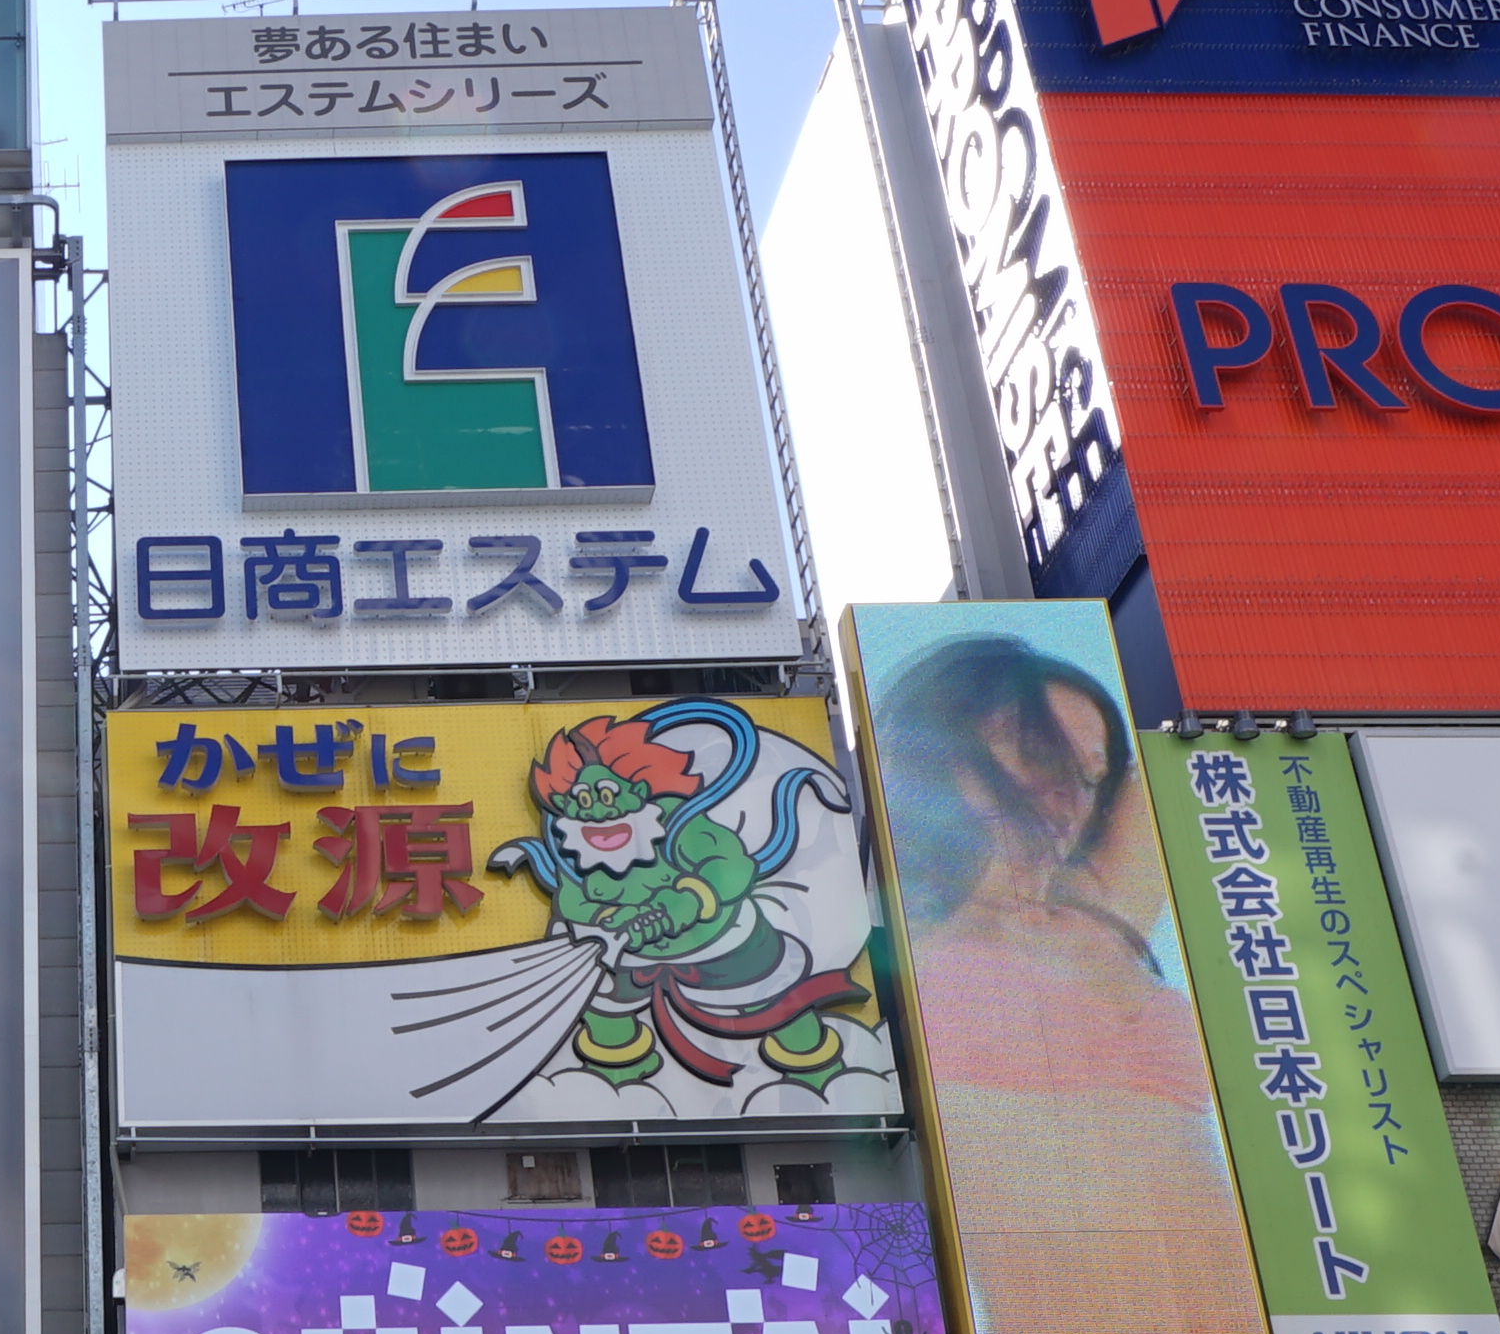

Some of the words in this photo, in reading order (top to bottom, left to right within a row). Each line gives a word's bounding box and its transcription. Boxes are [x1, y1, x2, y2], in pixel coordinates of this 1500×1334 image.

[252, 21, 550, 64] 夢ある住まい
[1303, 23, 1481, 50] FINANCE
[205, 72, 610, 118] エステムシリーズ
[135, 527, 782, 624] 日商エステム
[156, 718, 443, 796] かぜに
[127, 801, 486, 924] 改源
[1279, 754, 1410, 1166] 不動産再生のスペシャリスト
[1190, 752, 1370, 1301] 株式会社日本リート
